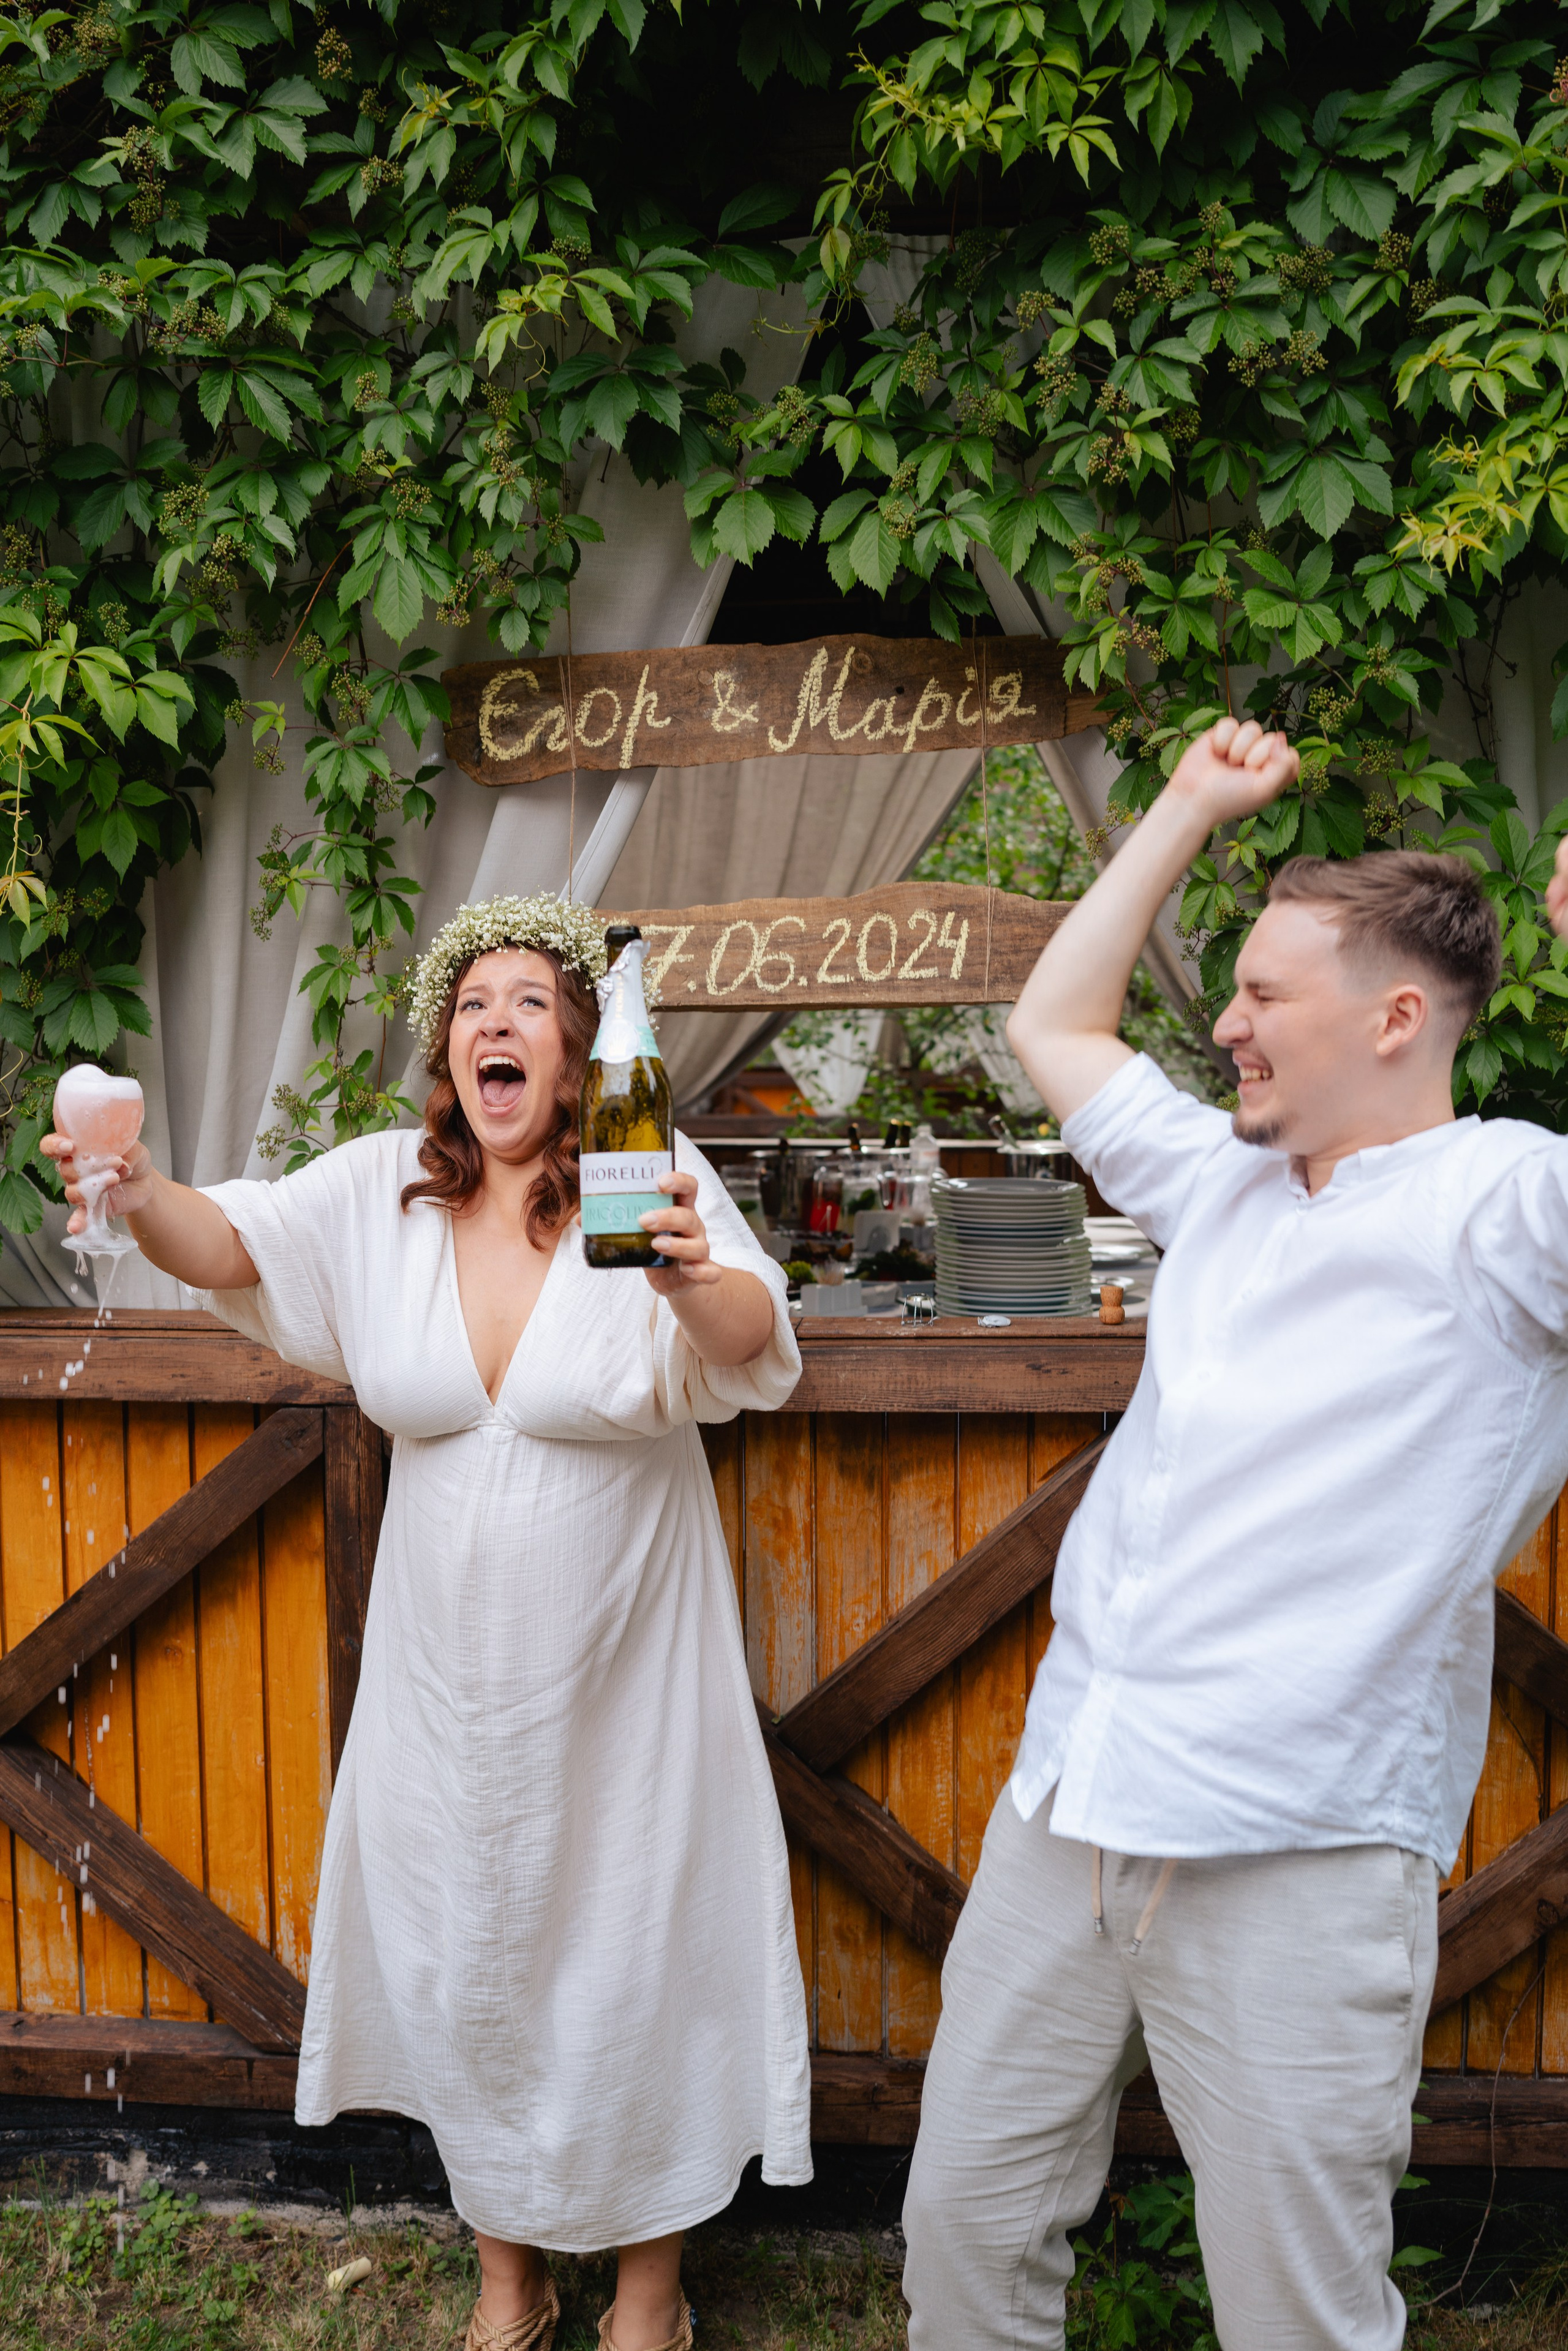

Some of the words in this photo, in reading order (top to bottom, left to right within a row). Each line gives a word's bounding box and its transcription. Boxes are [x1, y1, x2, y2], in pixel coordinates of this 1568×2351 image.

[711, 668, 760, 733] &
[608, 909, 970, 997] 7.06.2024
[585, 1166, 654, 1182] FIORELLI
